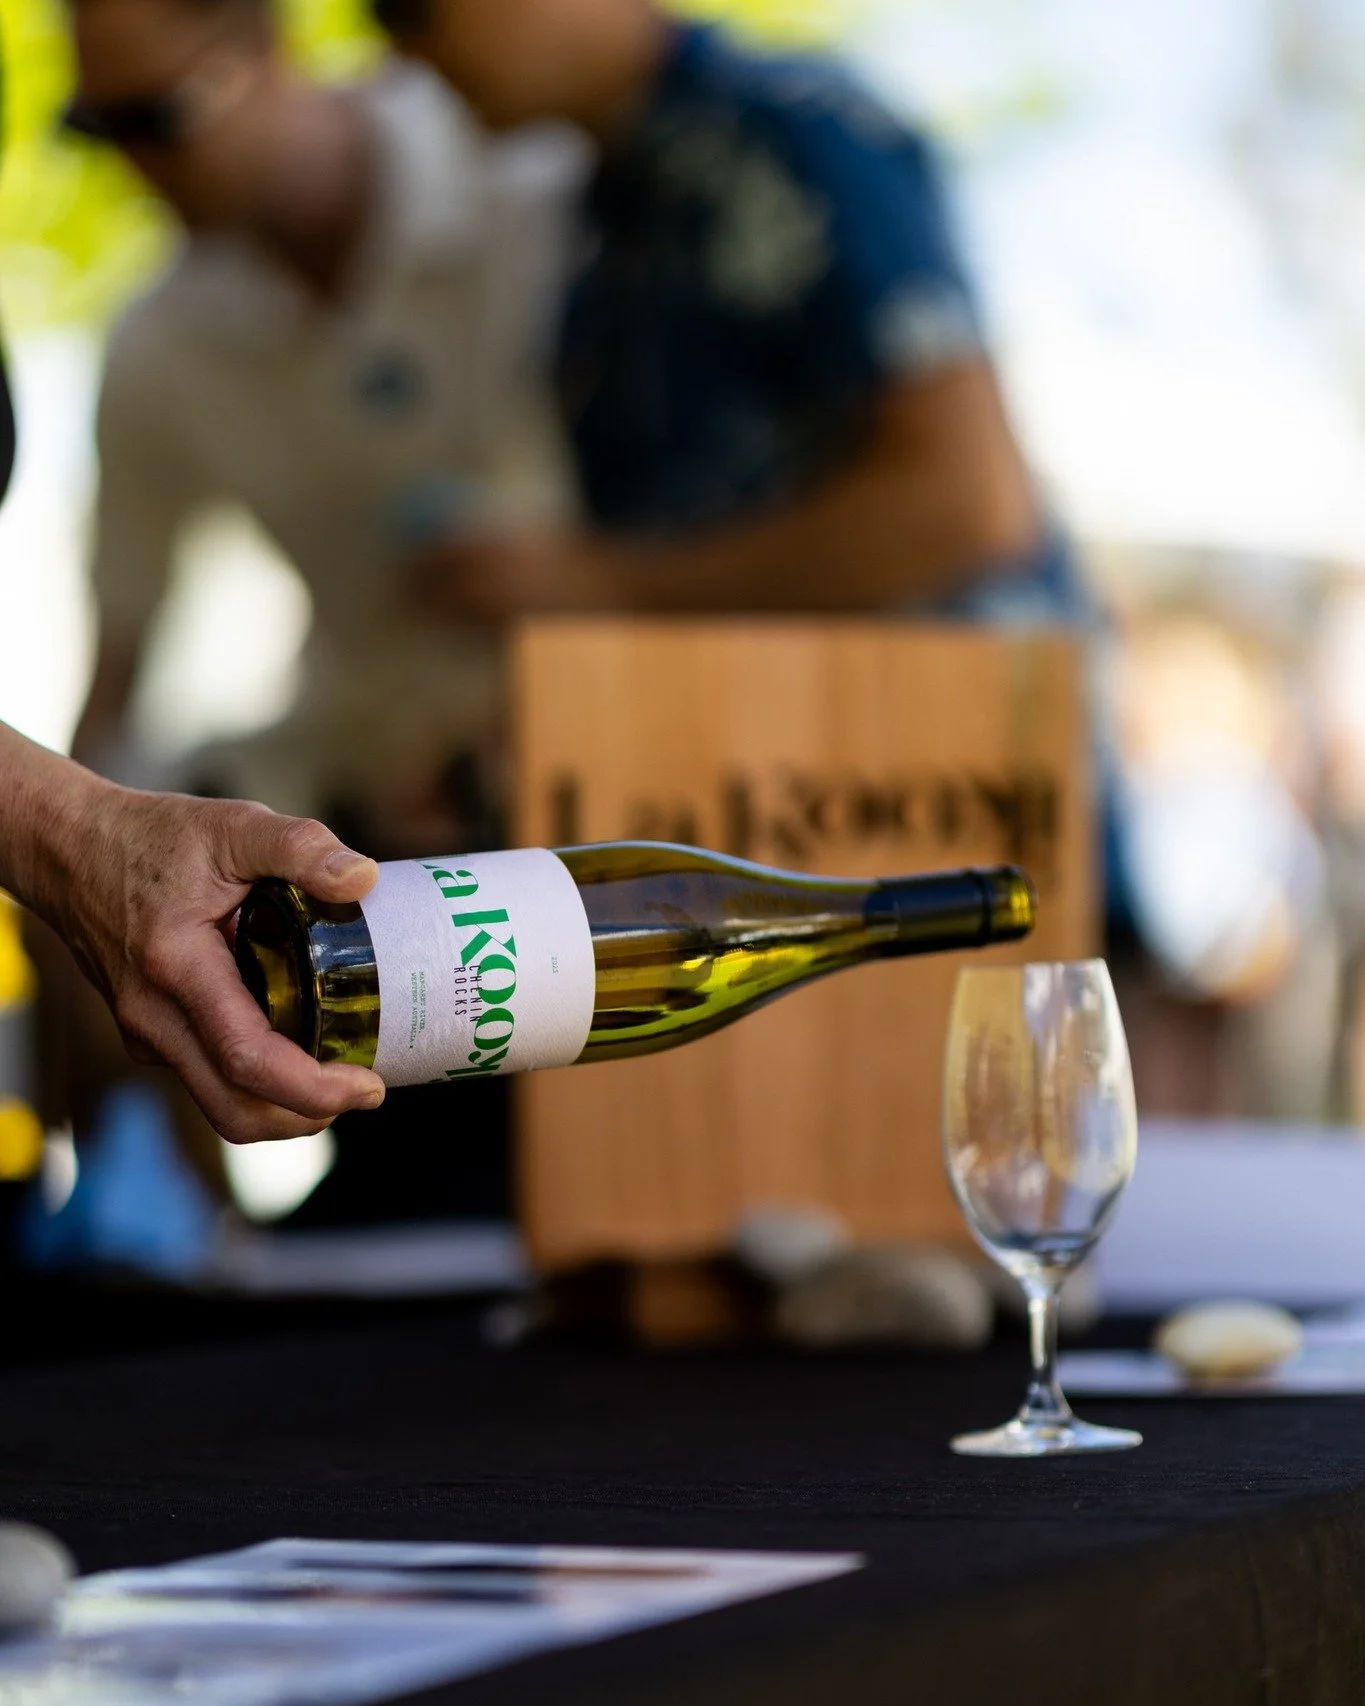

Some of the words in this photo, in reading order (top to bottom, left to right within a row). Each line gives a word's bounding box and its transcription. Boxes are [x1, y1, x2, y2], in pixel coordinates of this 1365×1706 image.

[411, 971, 419, 1004] WESTERN
[419, 971, 427, 1006] MARGARET
[454, 966, 468, 1016] ROCKS
[469, 964, 483, 1022] CHENIN
